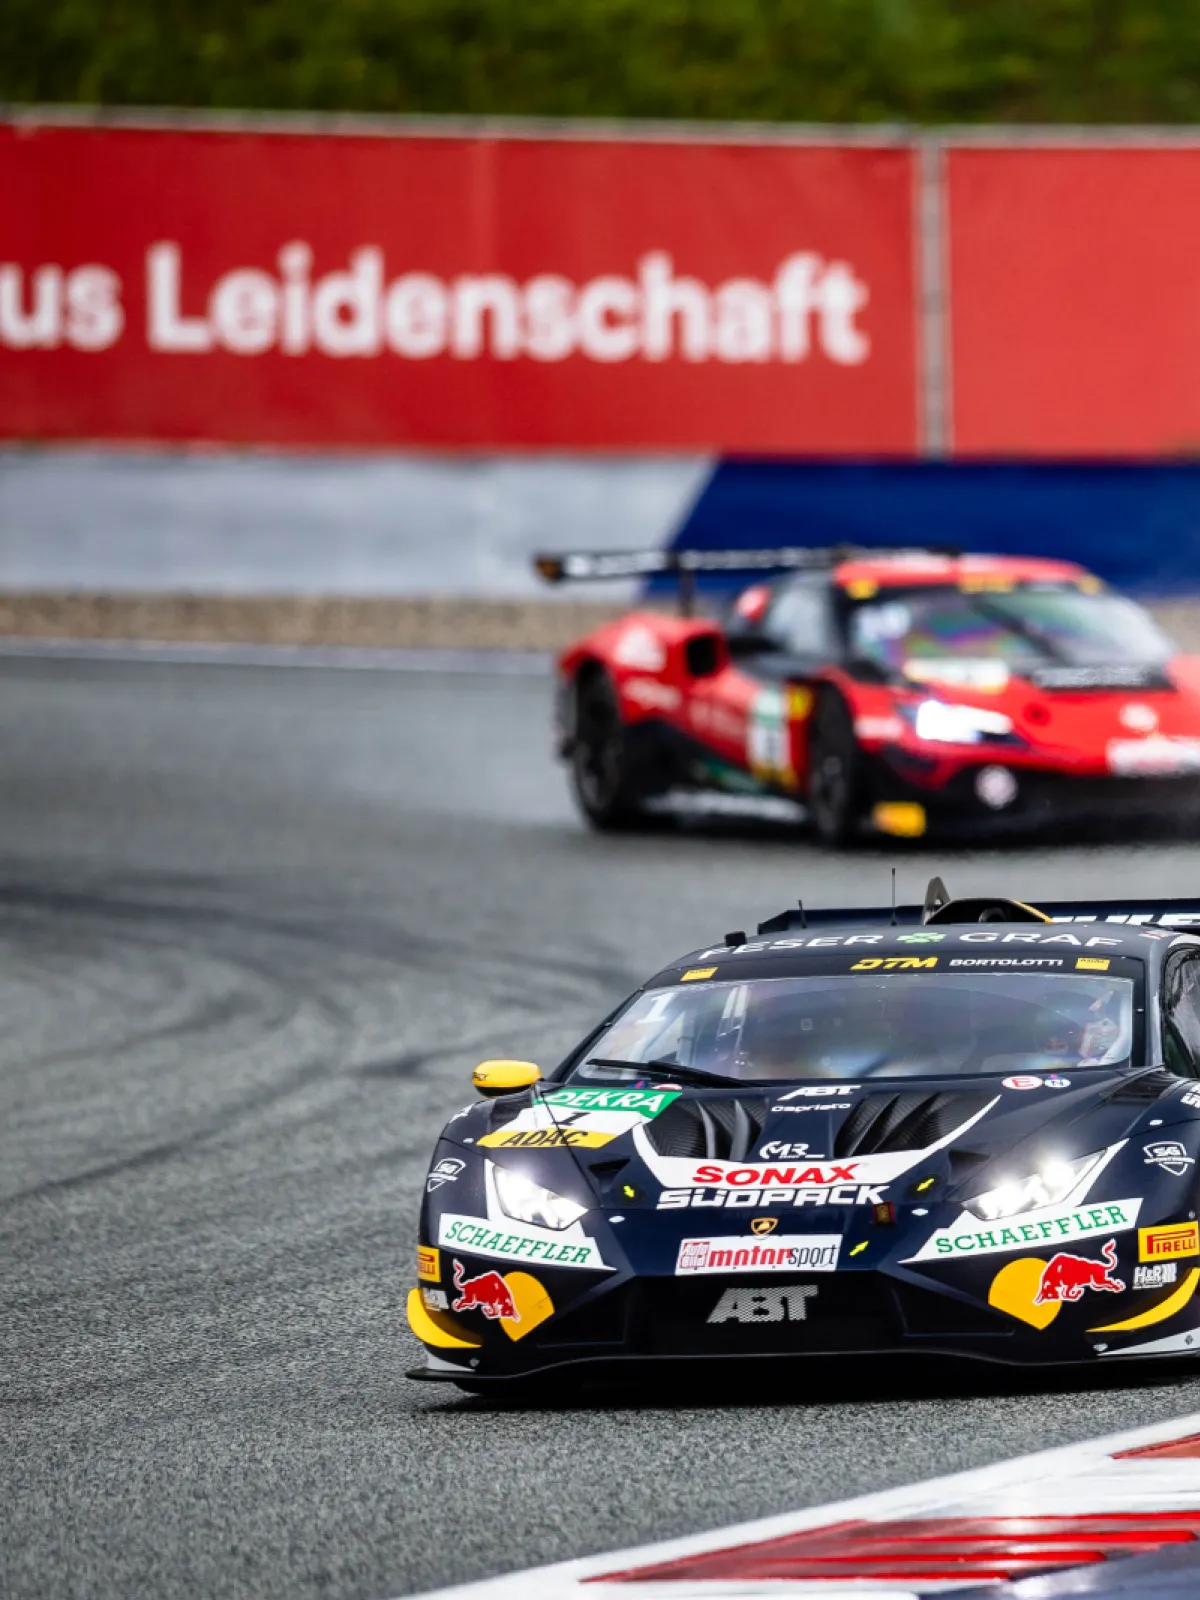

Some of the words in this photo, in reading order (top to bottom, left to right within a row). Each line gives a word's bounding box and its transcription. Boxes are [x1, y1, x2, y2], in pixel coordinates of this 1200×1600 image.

[145, 241, 869, 365] Leidenschaft
[698, 934, 884, 961] FESER
[958, 931, 1124, 948] GRAF
[849, 956, 939, 971] DTM
[949, 957, 1064, 967] BORTOLOTTI
[544, 1089, 666, 1113] DEKRA
[776, 1084, 862, 1102] ABT
[552, 1111, 591, 1127] 1
[500, 1129, 589, 1147] ADAC
[692, 1162, 861, 1186] SONAX
[935, 1205, 1129, 1255] SCHAEFFLER
[1146, 1229, 1196, 1255] PIRELLI
[444, 1221, 592, 1264] SCHAEFFLER
[705, 1284, 819, 1324] ABT
